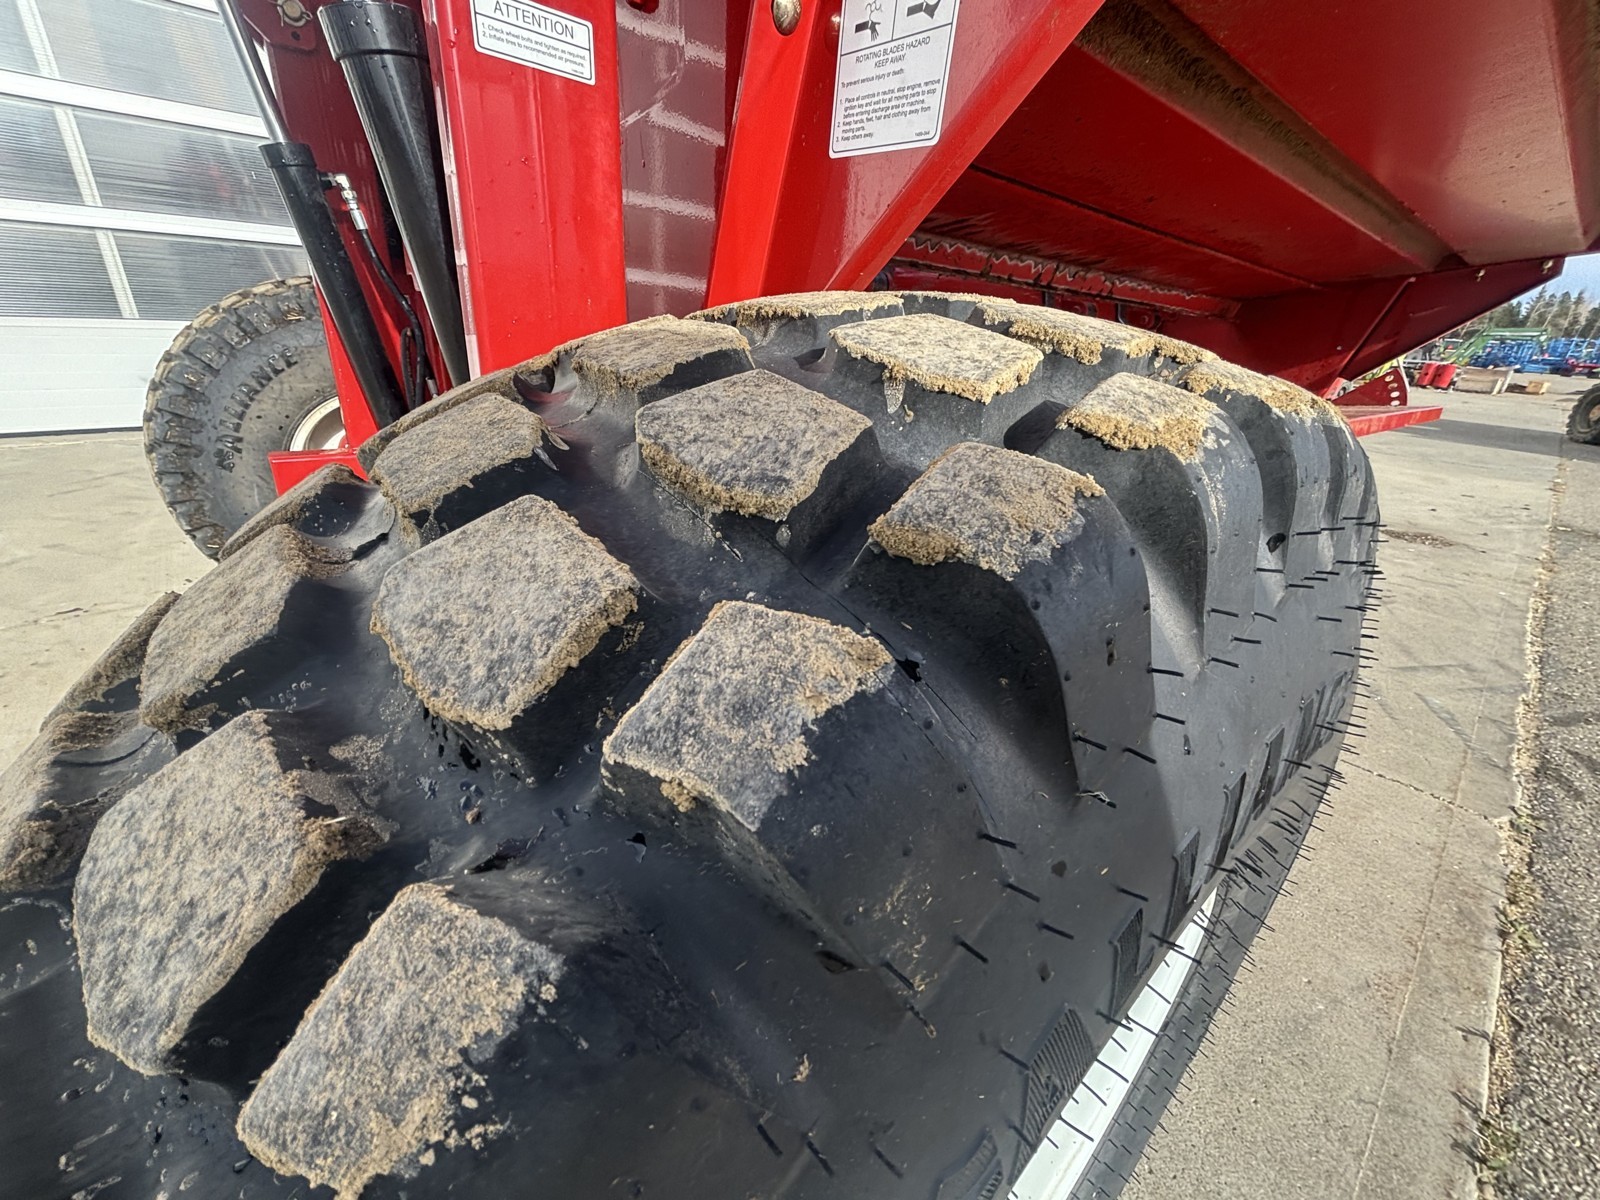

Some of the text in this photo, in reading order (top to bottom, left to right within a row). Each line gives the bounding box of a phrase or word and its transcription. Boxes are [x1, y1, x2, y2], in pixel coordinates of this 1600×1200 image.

[493, 0, 574, 39] ATTENTION
[488, 24, 504, 35] Check
[505, 31, 521, 40] wheel
[521, 35, 533, 44] bolts
[543, 42, 560, 52] tighten
[488, 32, 505, 43] Inflate
[505, 38, 517, 47] tires
[523, 44, 557, 60] recommended
[855, 35, 931, 64] ROTATING BLADES HAZARD
[874, 52, 906, 69] KEEP AWAY
[846, 79, 860, 88] prevent
[860, 76, 875, 84] serious
[875, 73, 886, 82] injury
[861, 92, 876, 101] controls
[923, 78, 941, 87] remove
[844, 104, 857, 113] ignition
[894, 93, 909, 101] moving
[909, 91, 921, 100] parts
[926, 87, 937, 95] stop
[871, 105, 890, 114] discharge
[890, 103, 901, 111] area
[883, 112, 891, 120] and
[891, 110, 908, 118] clothing
[920, 105, 931, 113] from
